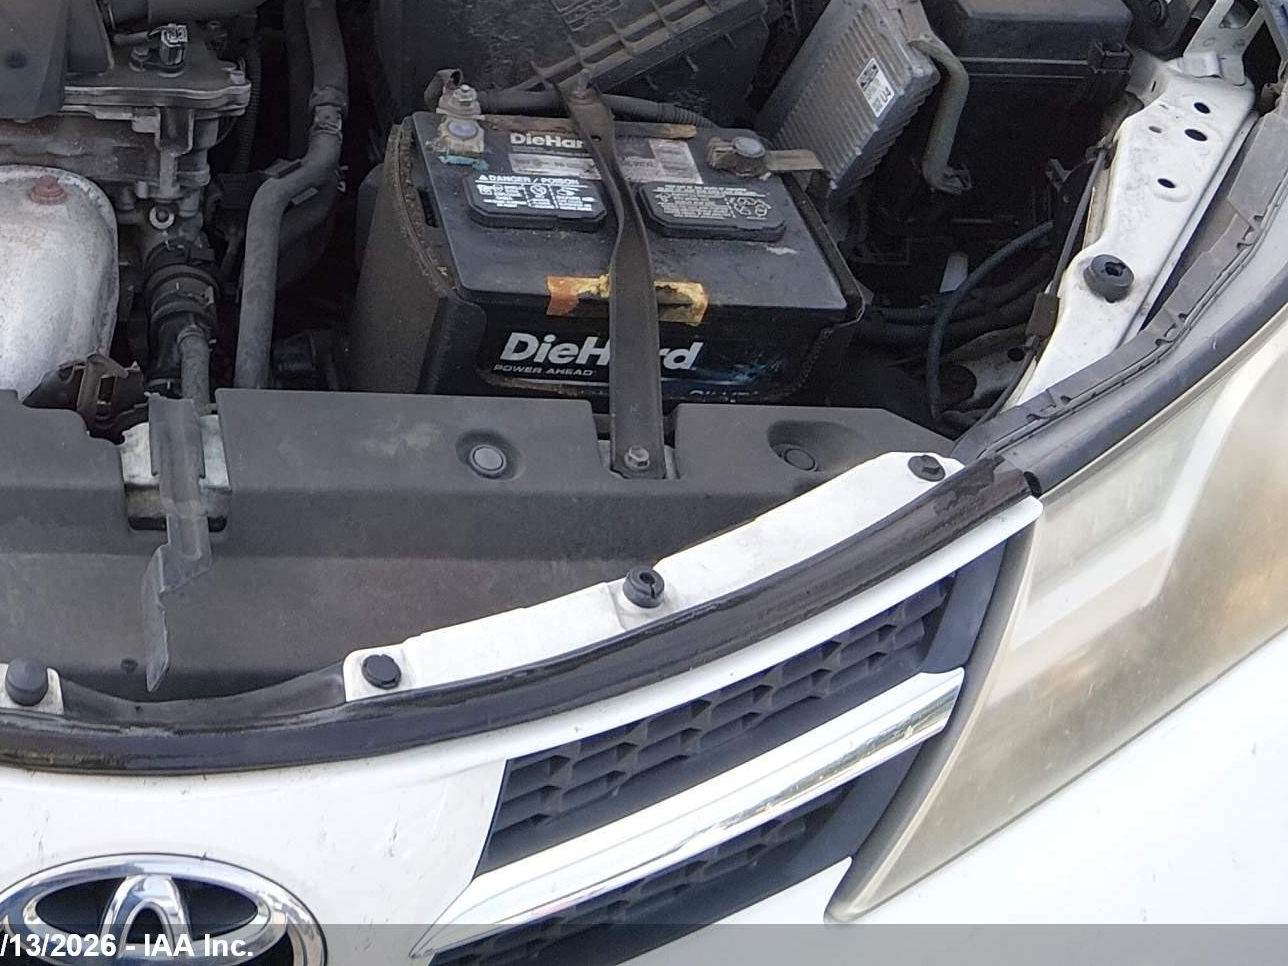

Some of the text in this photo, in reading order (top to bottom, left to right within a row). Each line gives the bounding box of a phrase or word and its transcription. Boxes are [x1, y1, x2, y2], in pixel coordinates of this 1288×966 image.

[510, 132, 584, 149] DieHar
[488, 174, 531, 183] DANGER
[540, 177, 580, 186] POISON
[493, 364, 593, 376] POWER AHEAD
